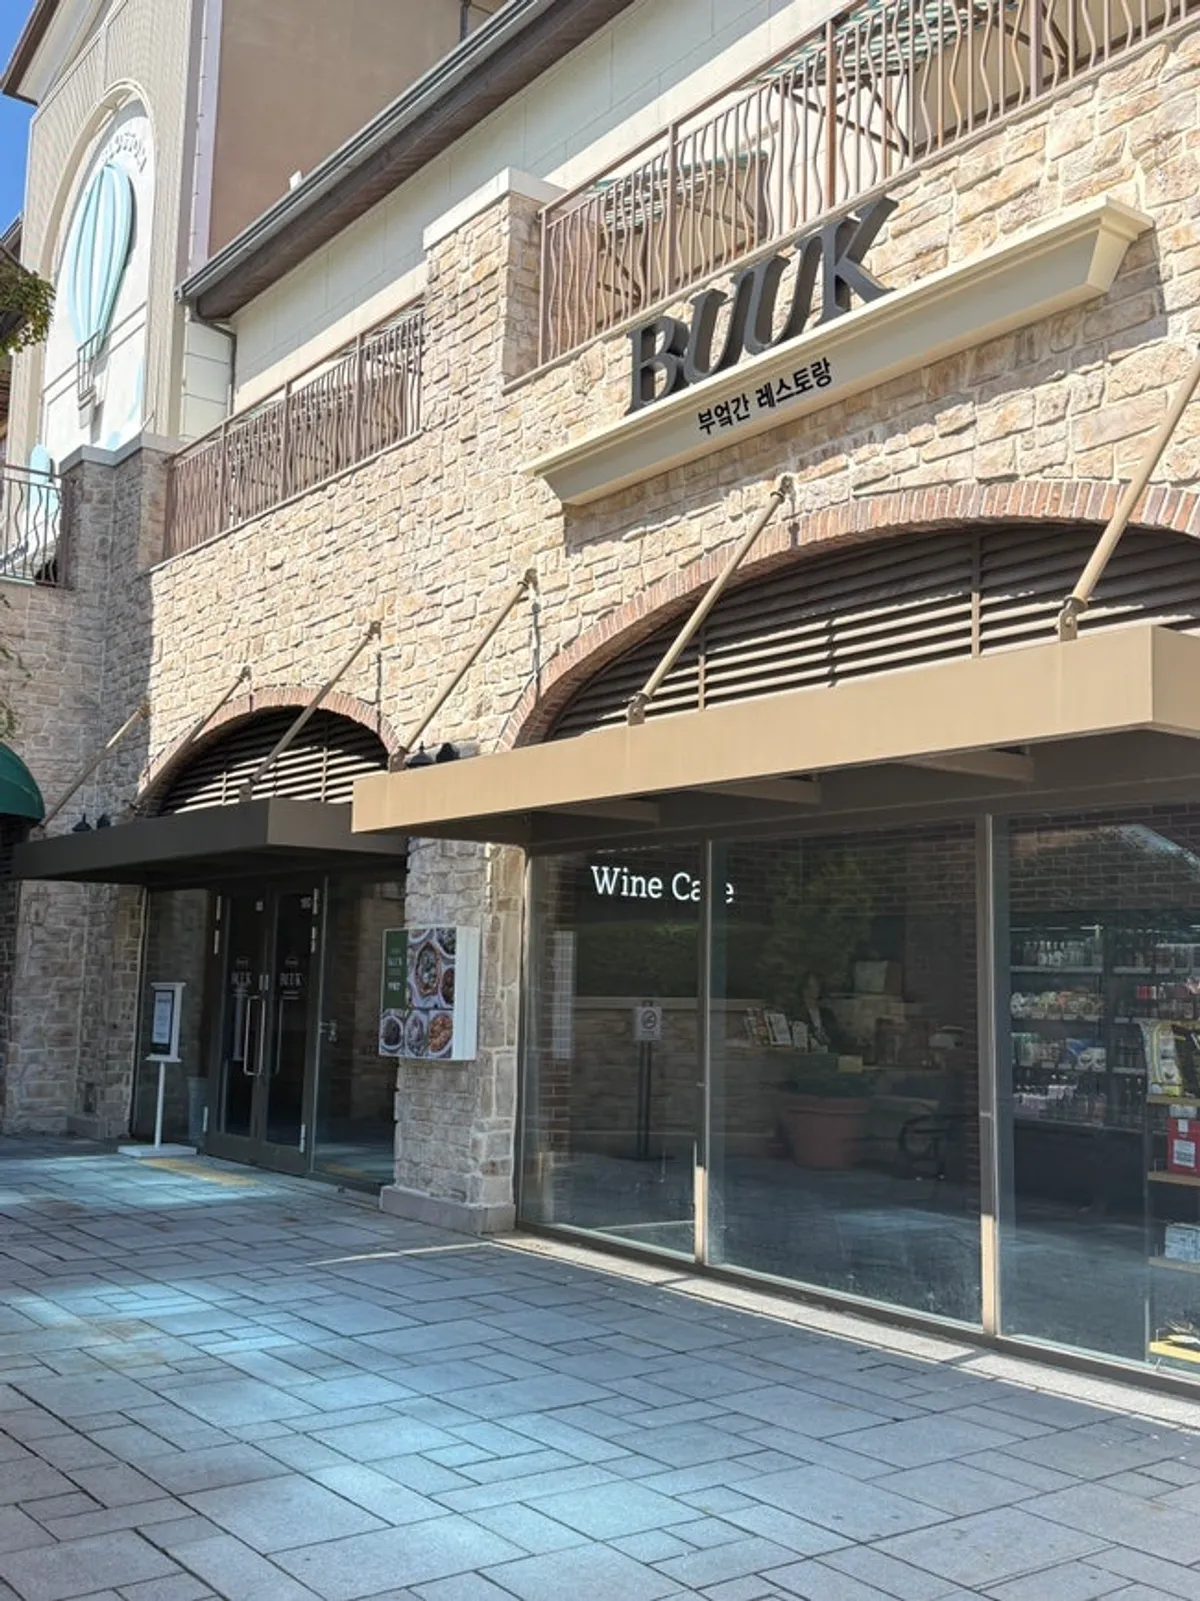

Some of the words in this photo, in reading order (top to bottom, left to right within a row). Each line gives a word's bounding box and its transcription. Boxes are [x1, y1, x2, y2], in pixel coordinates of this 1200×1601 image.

[625, 196, 899, 415] BUUK
[698, 393, 750, 435] 부엌간
[755, 357, 832, 408] 레스토랑
[591, 865, 663, 899] Wine
[672, 872, 734, 904] Cae
